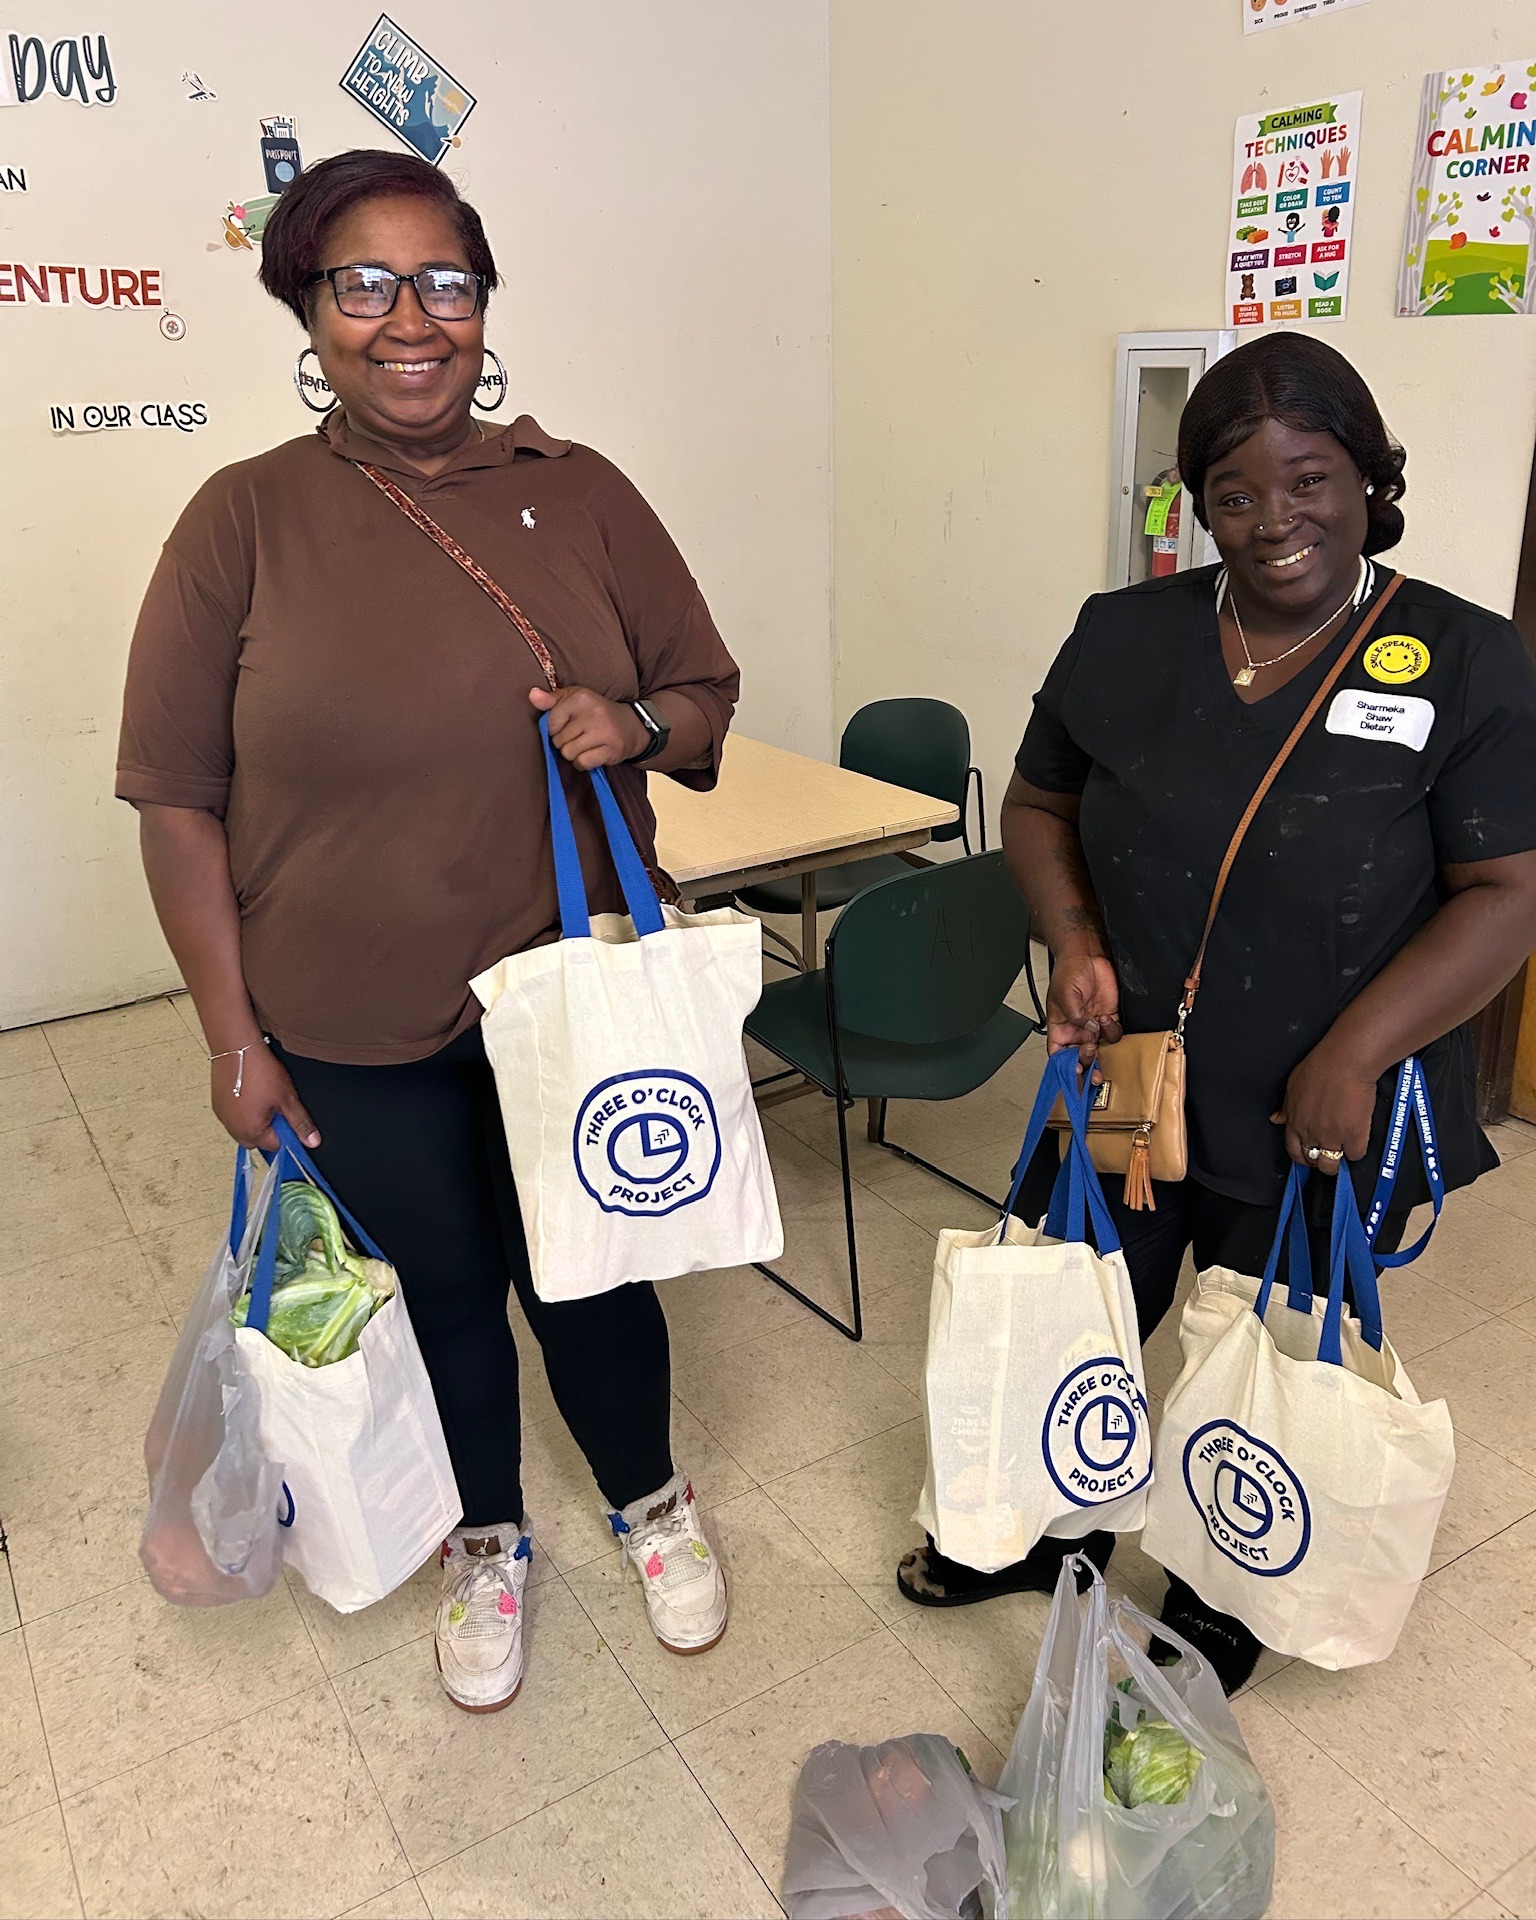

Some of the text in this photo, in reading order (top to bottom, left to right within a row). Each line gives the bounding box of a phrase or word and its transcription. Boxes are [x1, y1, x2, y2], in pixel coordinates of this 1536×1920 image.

[375, 31, 429, 84] CLIMB
[364, 50, 414, 103] TO NEW
[351, 67, 409, 126] HEIGHTS
[1271, 107, 1323, 129] CALMING
[1244, 124, 1347, 158] TECHNIQUES
[1427, 119, 1536, 157] CALMIN
[1446, 154, 1530, 179] CORNER
[1253, 199, 1266, 207] DEEP
[1283, 193, 1301, 201] COLOR
[1288, 200, 1304, 208] DRAW
[1323, 187, 1343, 196] COUNT
[1241, 206, 1264, 215] BREATHS
[1237, 254, 1249, 262] PLAY
[1239, 261, 1254, 269] QUIET
[1279, 252, 1301, 260] STRETCH
[50, 403, 208, 433] IN OUR CLASS
[1370, 646, 1382, 669] SMILE
[1383, 640, 1413, 650] SPEAK
[1357, 700, 1405, 714] Sharmeka
[1365, 712, 1393, 722] Shaw
[1360, 721, 1395, 734] Dietary
[1399, 1074, 1412, 1102] PARISH
[1395, 1101, 1407, 1127] ROUGE
[1416, 1089, 1428, 1117] PARISH
[586, 1088, 706, 1146] THREE O'CLOCK
[1421, 1116, 1433, 1144] LIBRARY
[1390, 1127, 1403, 1151] BATON
[1386, 1150, 1397, 1167] EAST
[608, 1173, 696, 1204] PROJECT
[1057, 1375, 1097, 1427] THREE
[1069, 1466, 1135, 1493] PROJECT
[1199, 1437, 1296, 1523] THREE O'CLOCK
[1206, 1504, 1269, 1561] PROJECT
